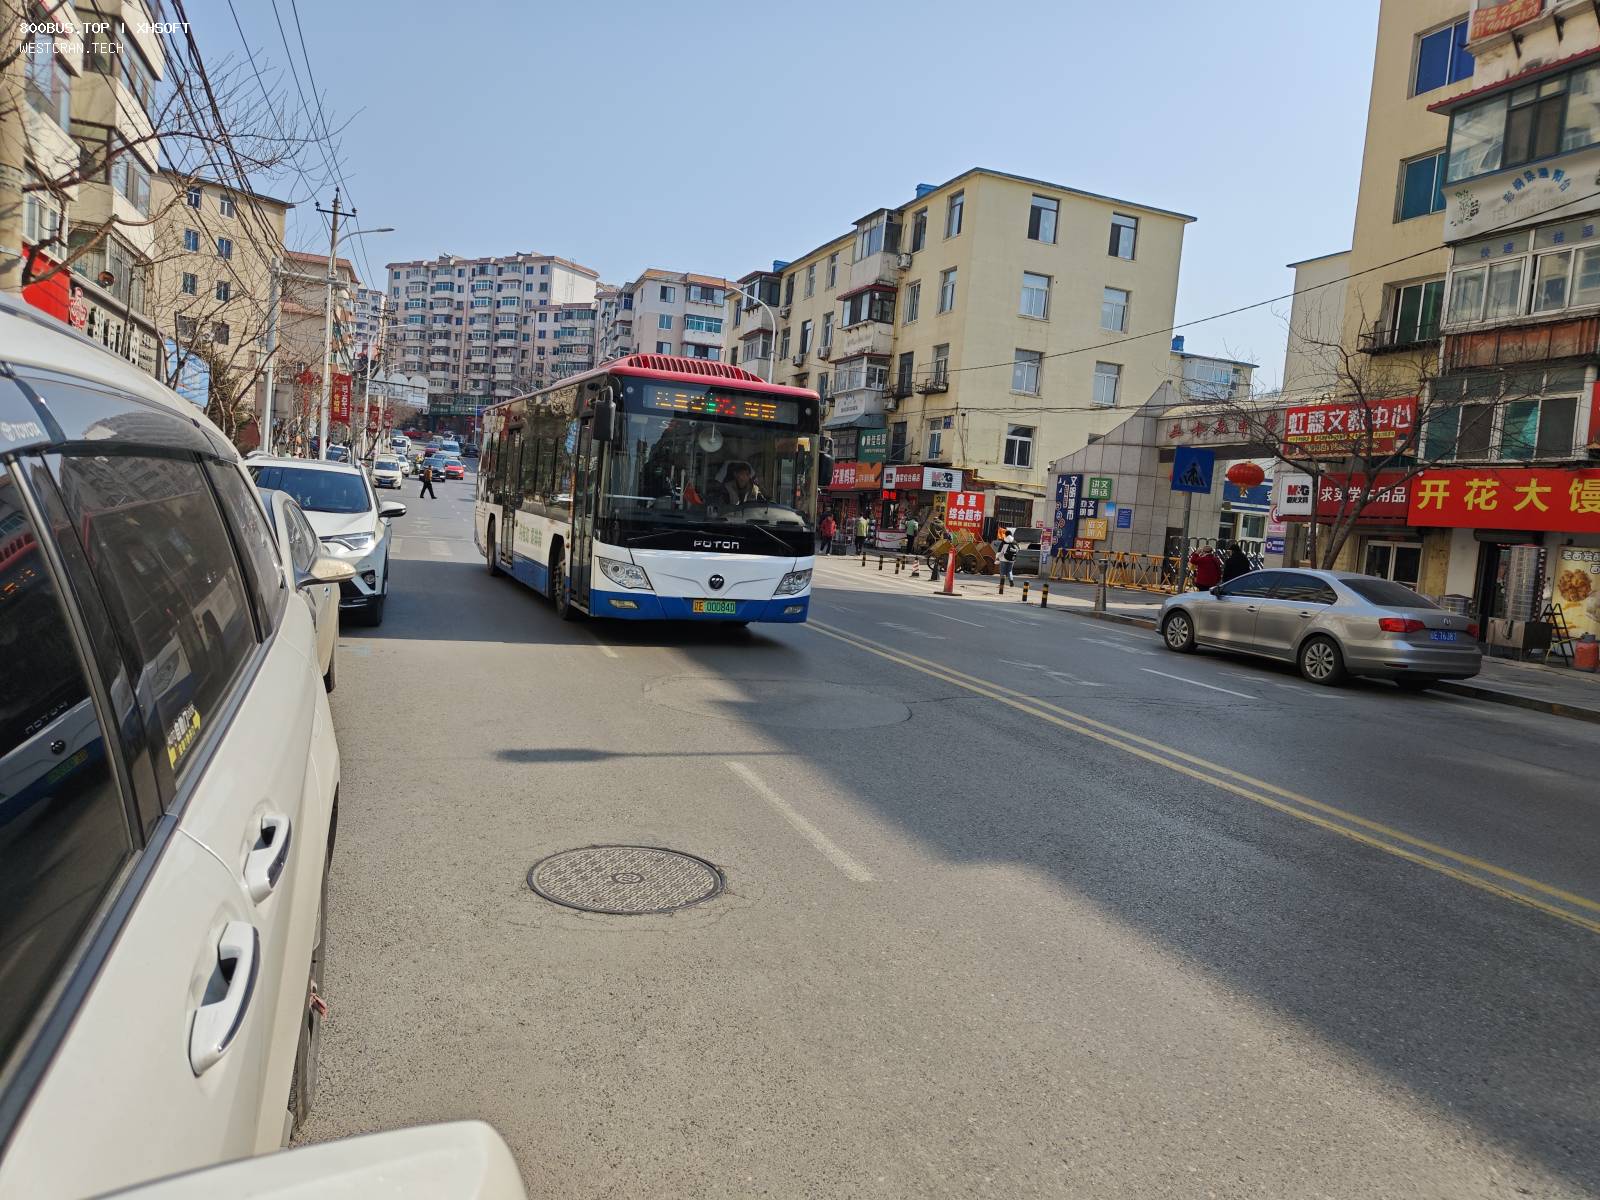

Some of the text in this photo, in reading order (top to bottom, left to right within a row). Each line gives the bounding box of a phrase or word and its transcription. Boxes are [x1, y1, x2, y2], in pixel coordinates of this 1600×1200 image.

[1287, 484, 1310, 496] M&G
[948, 508, 982, 522] 综合超市
[693, 539, 740, 550] FOTON
